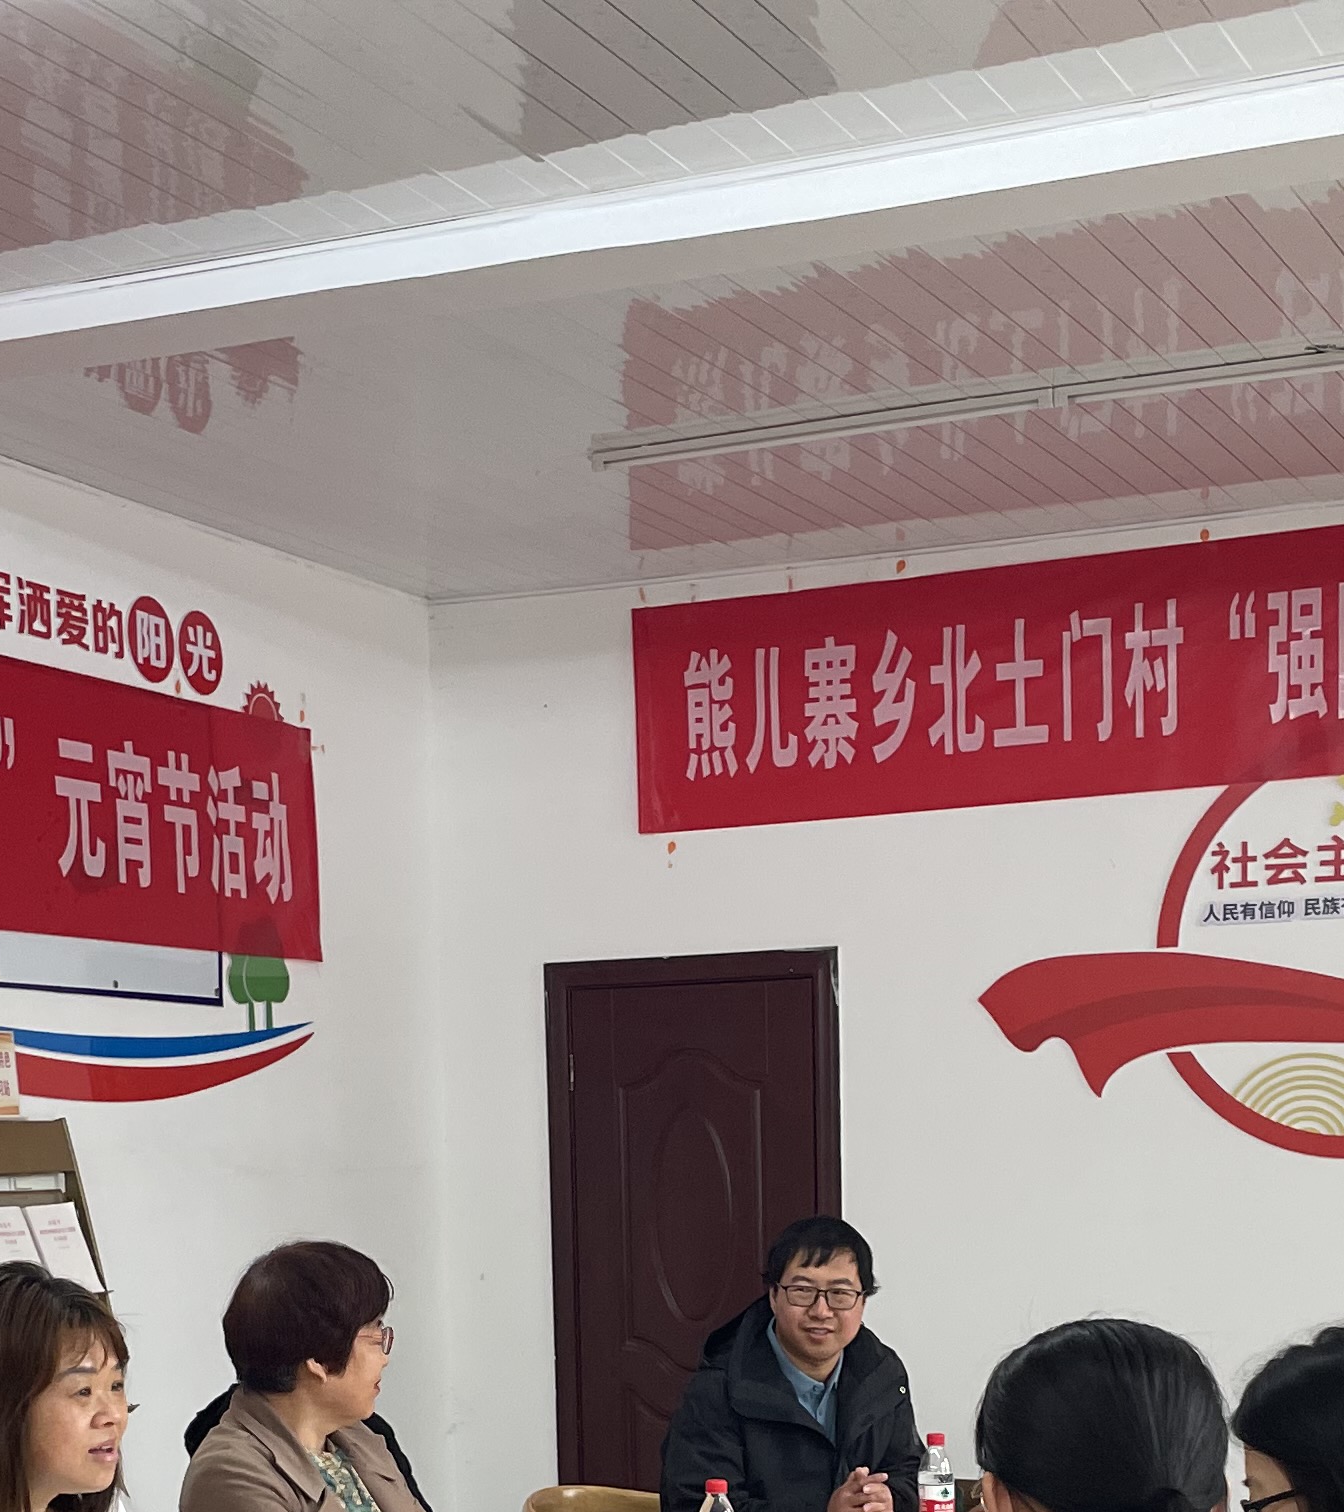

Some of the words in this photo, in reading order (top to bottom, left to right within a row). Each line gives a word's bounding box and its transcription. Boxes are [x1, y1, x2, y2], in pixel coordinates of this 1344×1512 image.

[683, 598, 1184, 782] 熊儿寨乡北土门村
[54, 737, 293, 905] 元宵节活动
[1203, 901, 1295, 923] 人民有信仰
